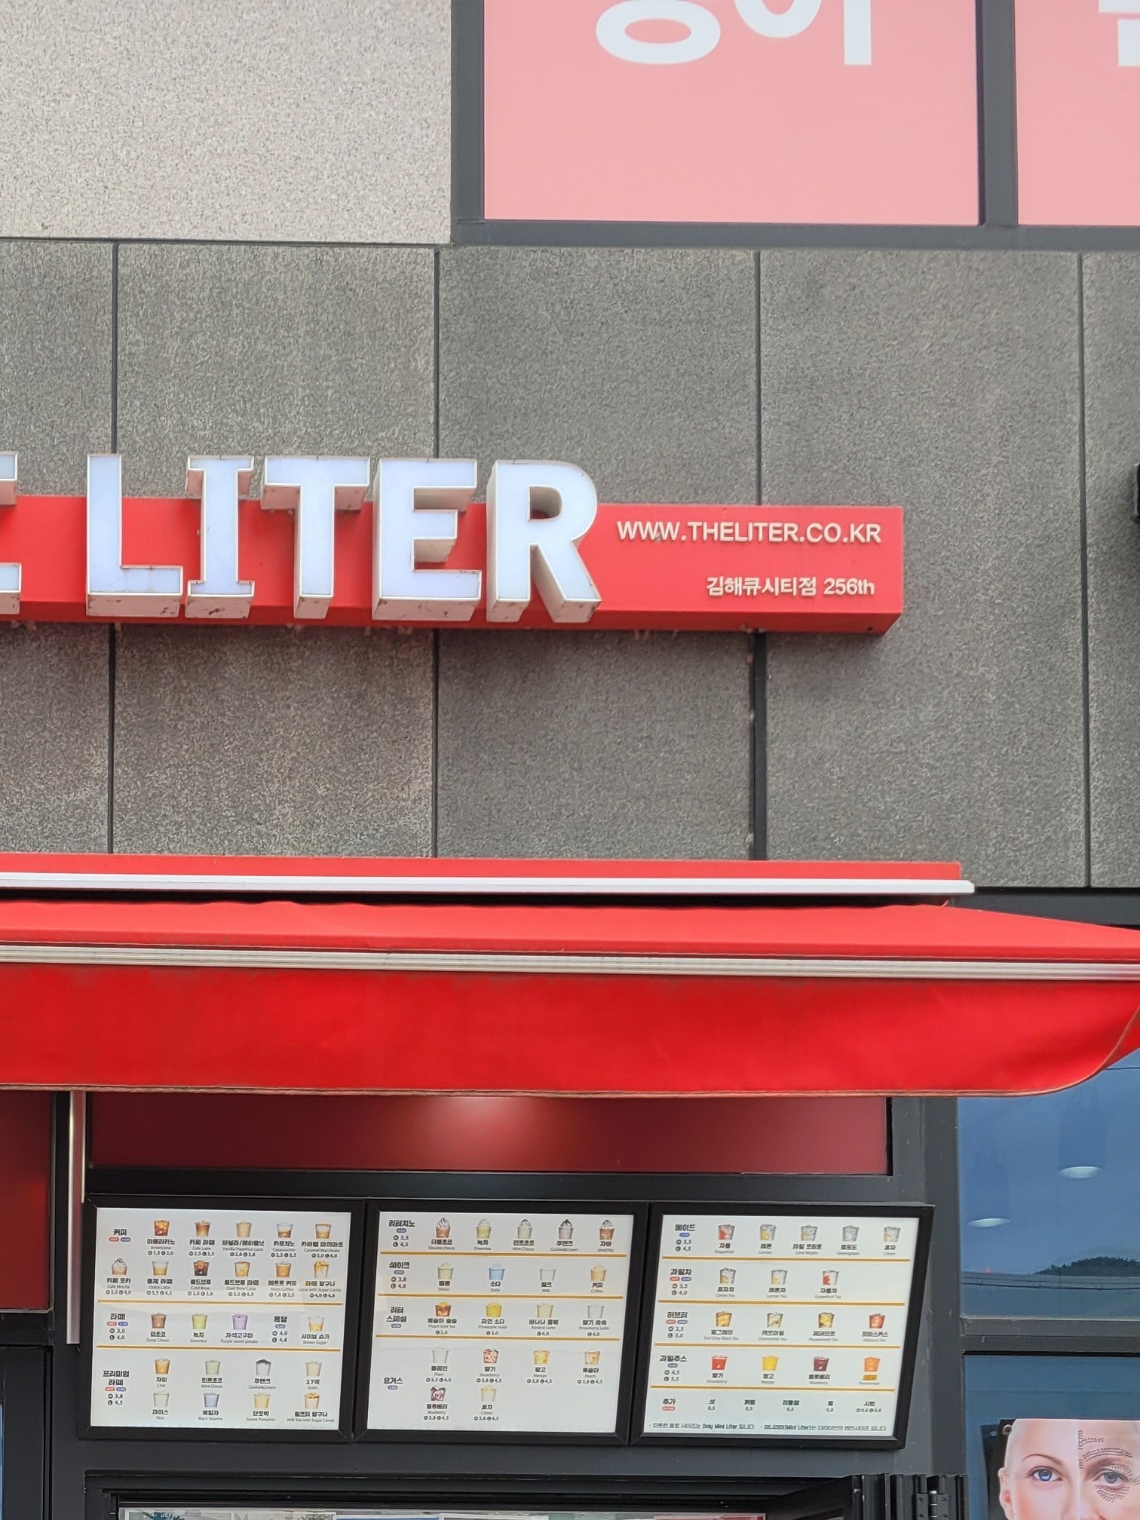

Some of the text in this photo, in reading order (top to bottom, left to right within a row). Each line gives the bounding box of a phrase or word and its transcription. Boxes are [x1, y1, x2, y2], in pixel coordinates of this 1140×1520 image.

[86, 453, 601, 605] LITER
[617, 521, 881, 544] WWW.THELITER.CO.KR
[707, 576, 875, 597] 김해큐시티점 256th
